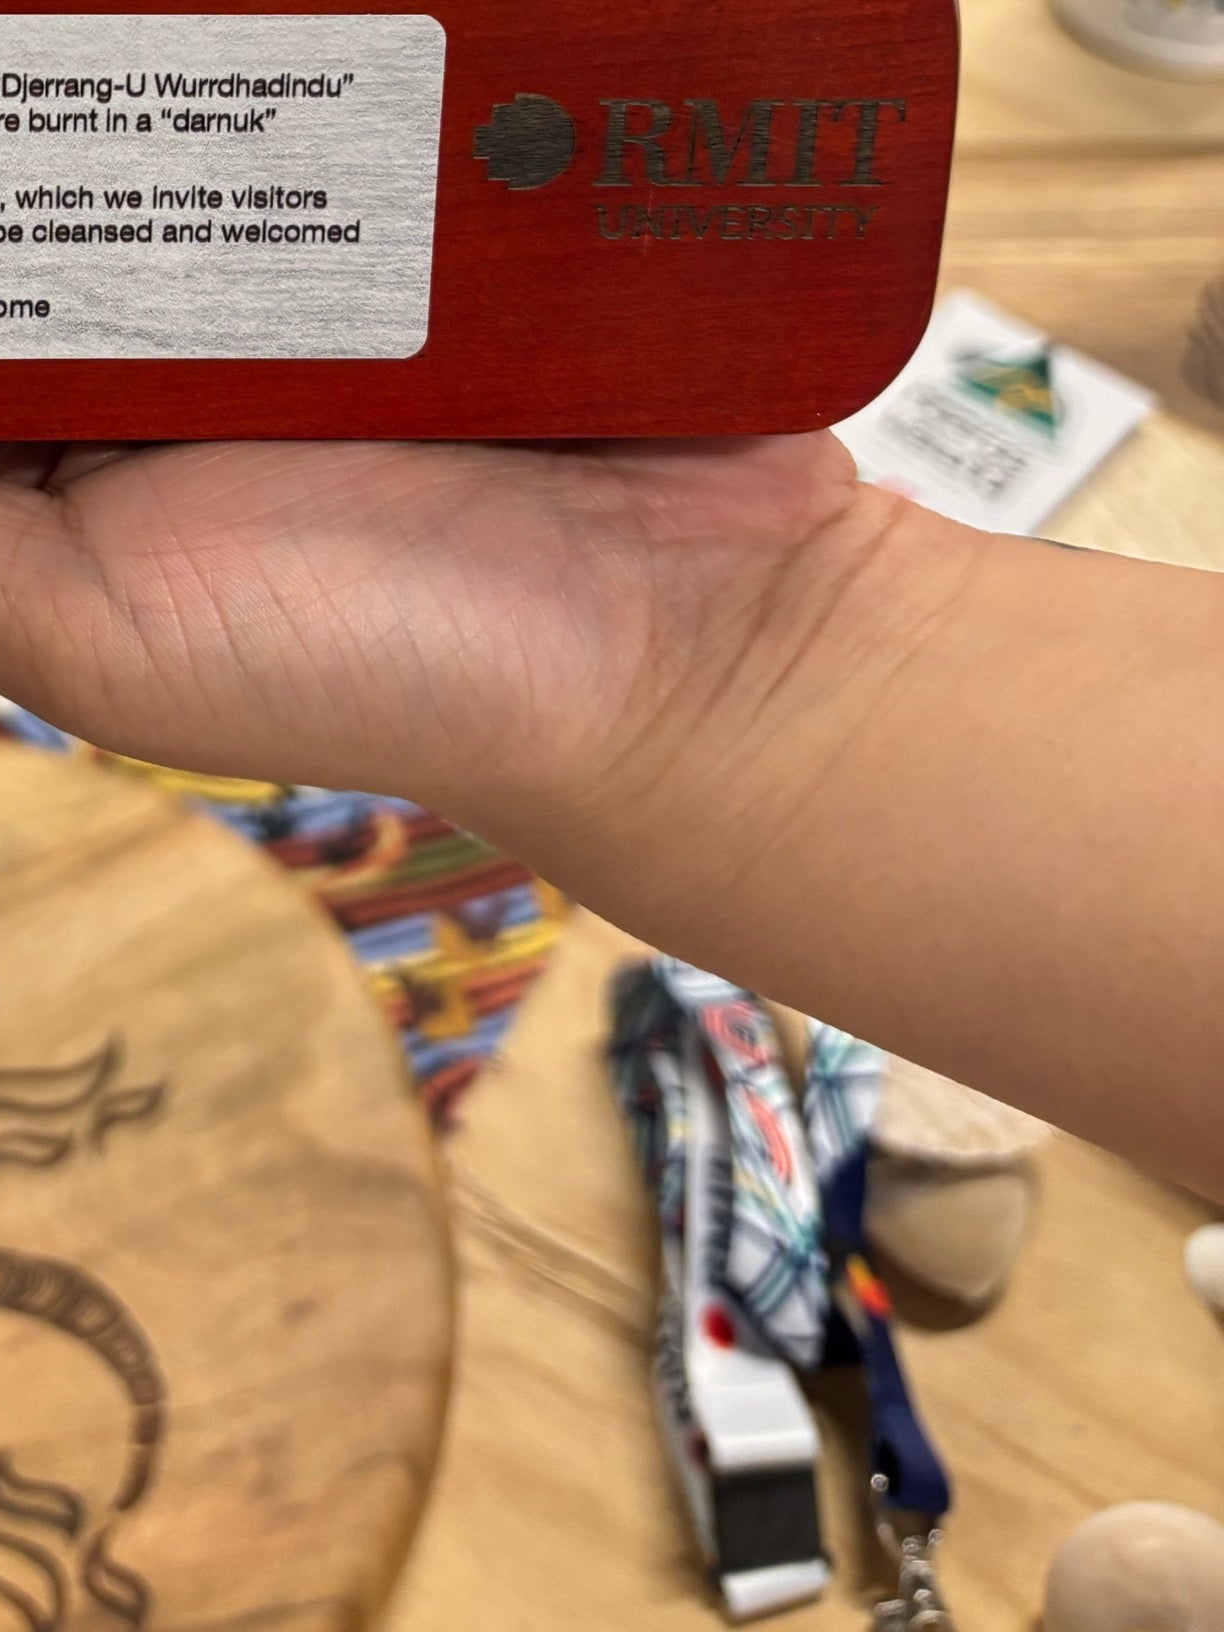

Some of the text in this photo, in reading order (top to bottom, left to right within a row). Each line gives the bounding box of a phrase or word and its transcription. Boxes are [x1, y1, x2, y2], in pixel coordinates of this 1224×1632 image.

[153, 72, 355, 99] Wurrdhadindu”
[27, 107, 99, 134] burnt
[105, 107, 129, 134] in
[134, 112, 153, 134] a
[160, 107, 278, 134] “darnuk”
[592, 98, 907, 187] RMIT
[14, 184, 95, 210] which
[102, 189, 144, 210] we
[151, 184, 224, 211] invite
[230, 184, 329, 210] visitors
[31, 218, 154, 245] cleansed
[161, 218, 213, 244] and
[219, 218, 362, 245] welcomed
[596, 203, 878, 241] UNIVERSITY
